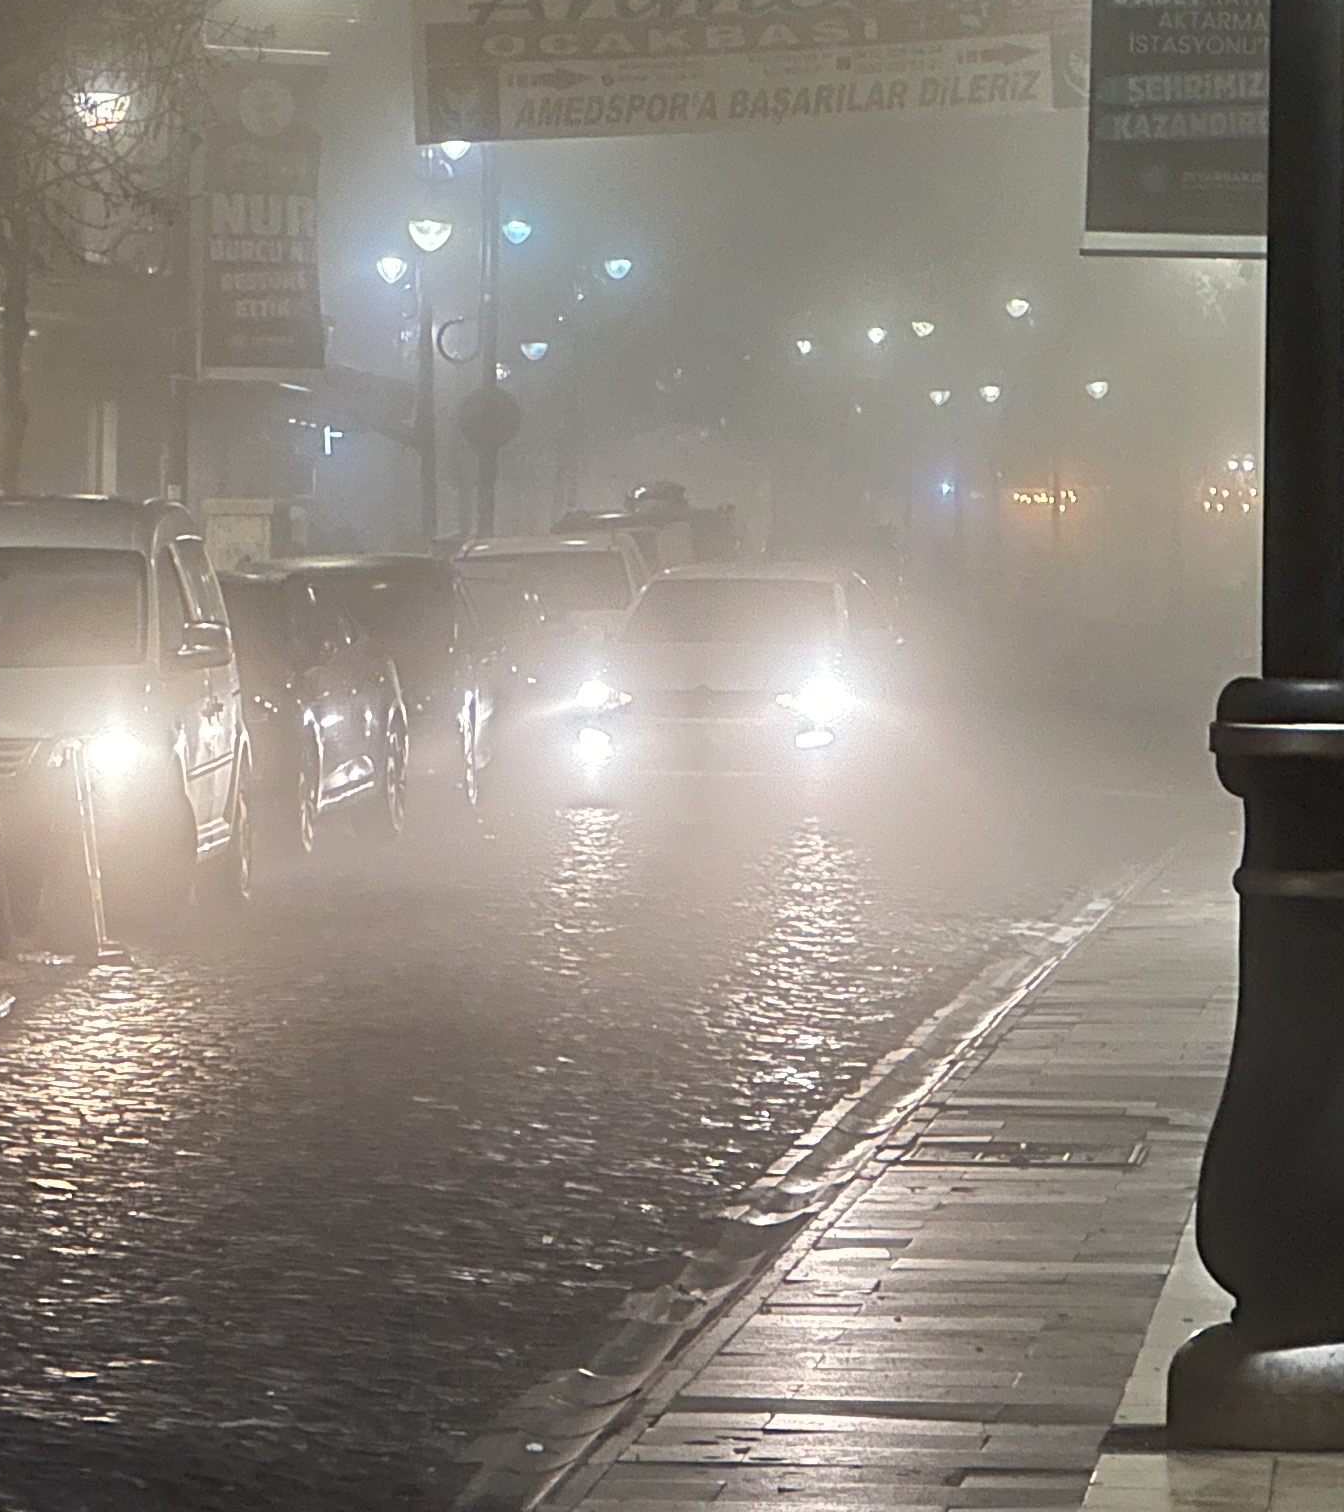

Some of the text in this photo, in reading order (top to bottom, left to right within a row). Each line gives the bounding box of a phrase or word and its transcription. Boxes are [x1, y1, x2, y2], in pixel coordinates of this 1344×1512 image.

[1158, 11, 1268, 31] AKTARMA
[515, 69, 1041, 128] AMEDSPOR'A BAŞARILAR DİLERİZ
